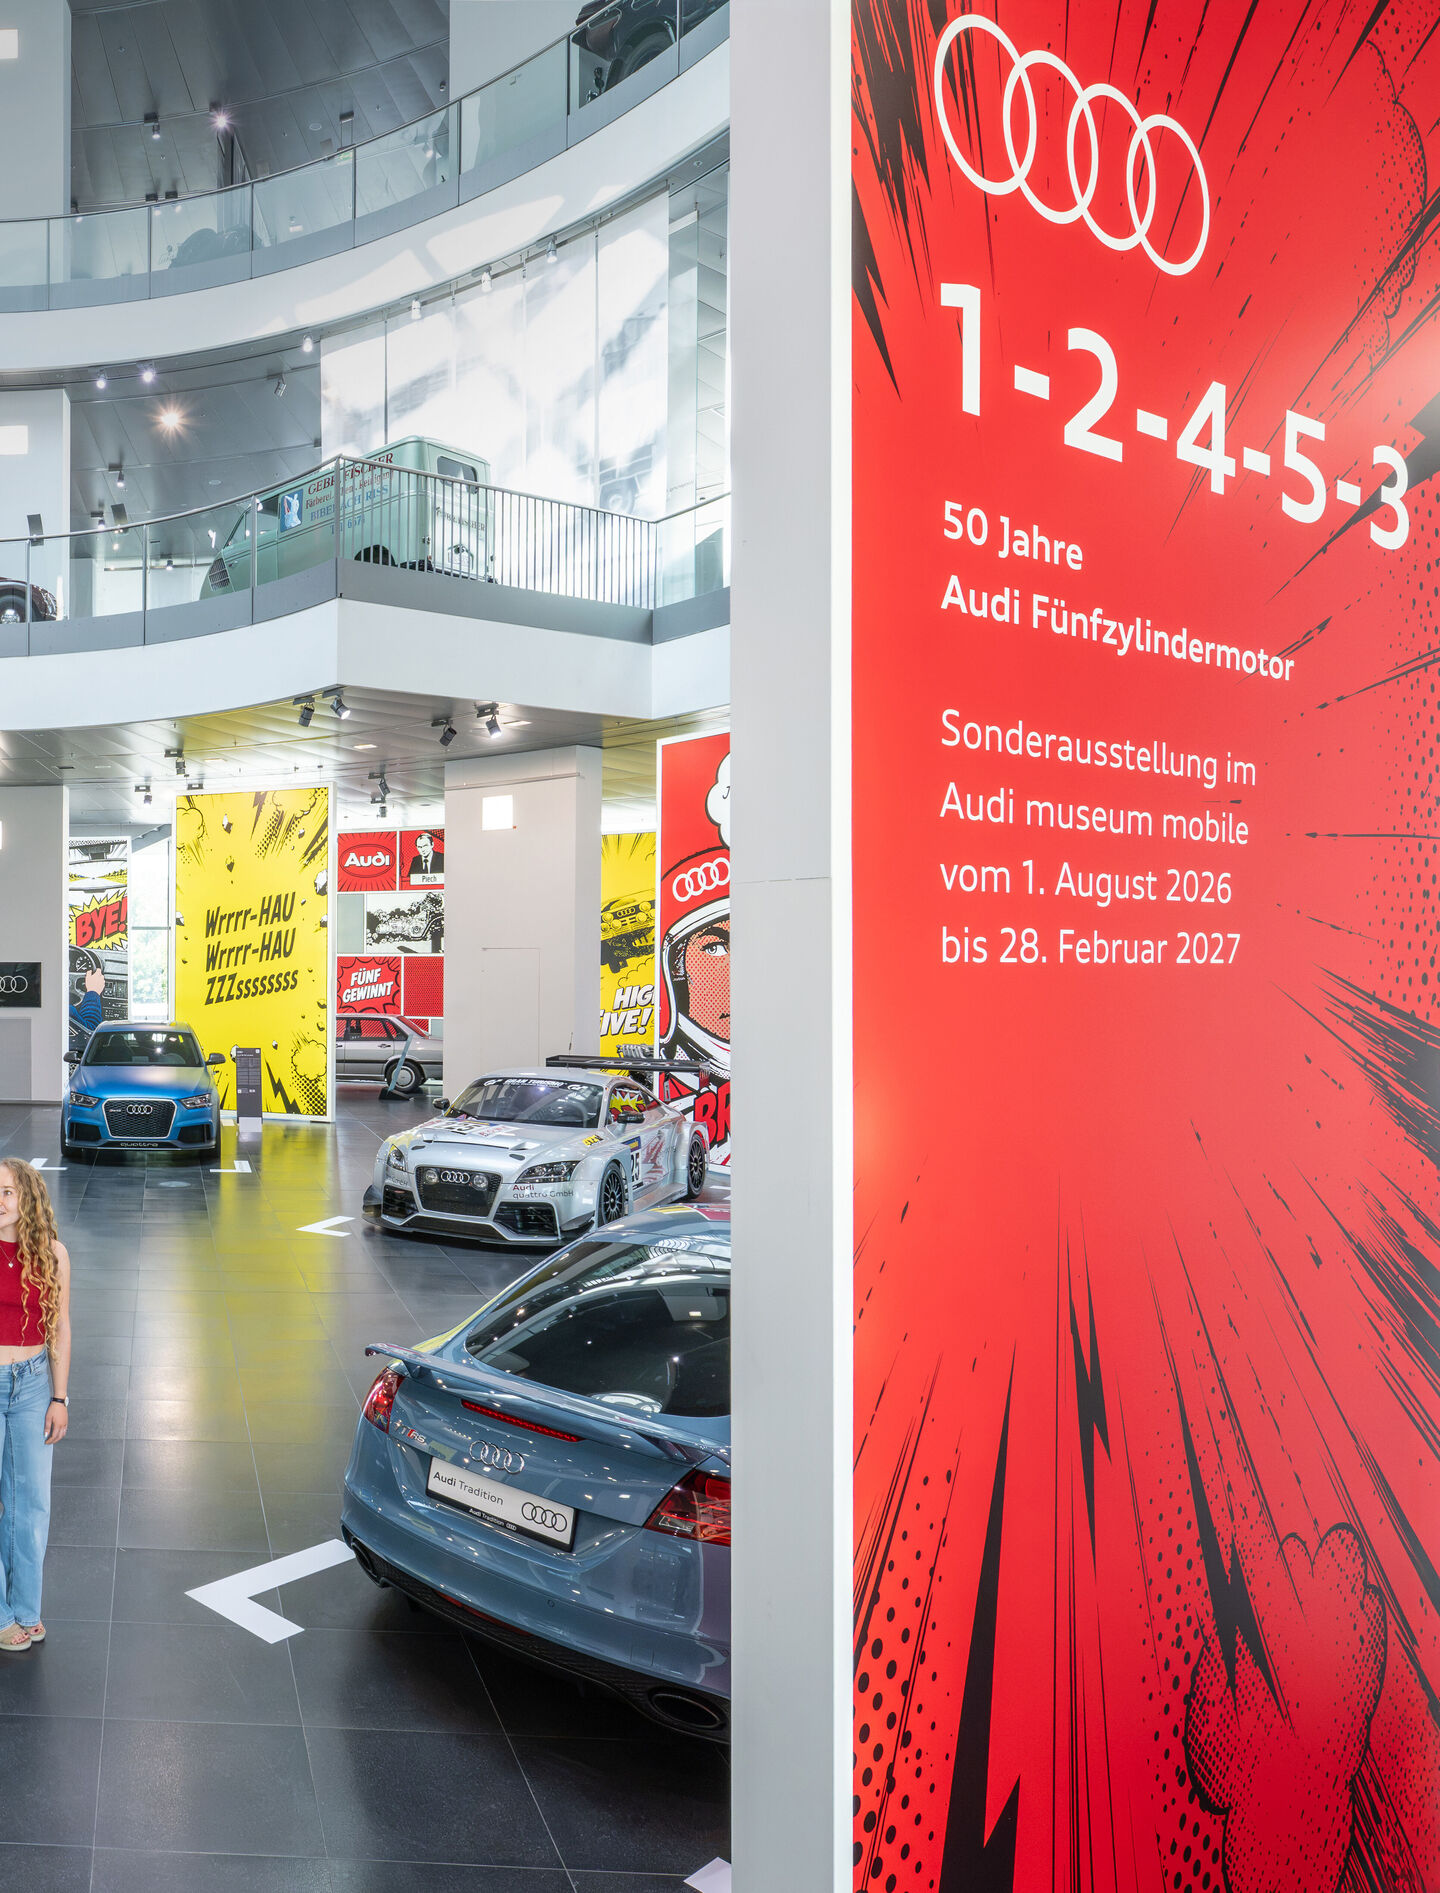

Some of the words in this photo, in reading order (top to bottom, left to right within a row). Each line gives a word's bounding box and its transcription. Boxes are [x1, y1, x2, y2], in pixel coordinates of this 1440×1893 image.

[940, 282, 1410, 551] 1-2-4-5-3
[310, 494, 361, 521] BIBEACH
[943, 500, 988, 546] 50
[998, 515, 1083, 570] Jahre
[940, 574, 1020, 625] Audi
[1032, 593, 1295, 681] Fünfzylindermotor
[940, 708, 1218, 789] Sonderausstellung
[1226, 752, 1256, 786] im
[939, 781, 1014, 824] Audi
[1026, 797, 1153, 836] museum
[1163, 810, 1249, 845] mobile
[344, 851, 390, 867] Audi
[940, 862, 1010, 894] vom
[1022, 859, 1045, 895] 1.
[1055, 861, 1157, 907] August
[1166, 868, 1232, 904] 2026
[75, 895, 128, 947] BYE!
[205, 891, 296, 938] Wrrrr-HAU
[205, 927, 297, 973] Wrrrr-HAU
[941, 926, 988, 964] bis
[998, 927, 1048, 964] 28.
[1059, 929, 1168, 964] Februar
[1175, 932, 1241, 964] 2027
[204, 969, 298, 1006] ZZZssssssss
[342, 981, 394, 1003] GEWINNT
[350, 967, 382, 987] FÜNF
[613, 984, 654, 1011] HIG
[120, 1141, 158, 1149] quattro
[512, 1191, 547, 1199] quattro
[549, 1190, 574, 1198] GmbH
[433, 1471, 457, 1487] Audi
[458, 1480, 504, 1506] Tradition
[469, 1508, 481, 1517] Audi
[482, 1512, 505, 1526] Tradition
